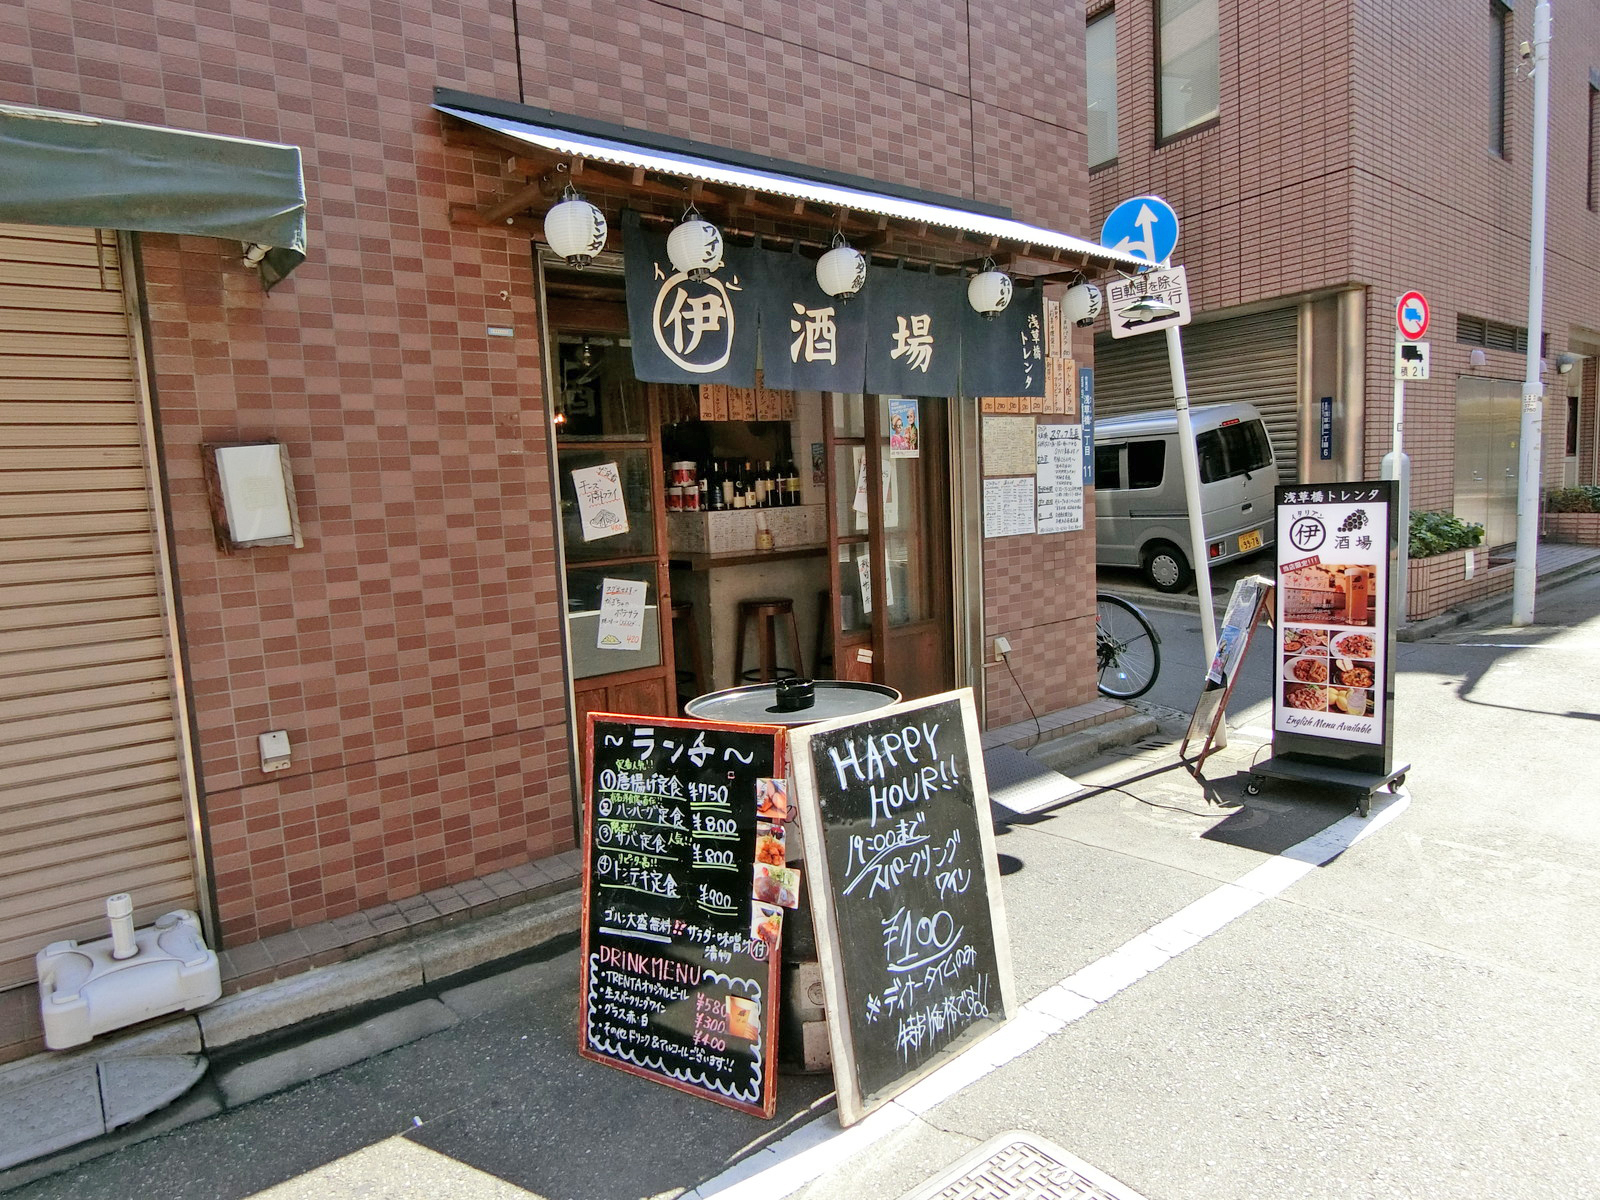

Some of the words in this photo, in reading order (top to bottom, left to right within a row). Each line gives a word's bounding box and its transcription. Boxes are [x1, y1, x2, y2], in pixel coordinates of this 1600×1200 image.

[703, 225, 720, 263] ワイン
[995, 276, 1010, 307] わいん
[1110, 274, 1181, 300] 自転車を除く
[1085, 286, 1100, 316] トレンタ
[1113, 289, 1183, 312] 一通行
[662, 287, 727, 355] 伊
[1027, 313, 1042, 361] 浅草橋
[1019, 330, 1034, 390] トレンタ
[1323, 448, 1329, 456] 6
[1083, 465, 1092, 478] 11
[579, 479, 602, 494] チーズ
[1283, 489, 1379, 504] 浅草橋トレンタ
[1295, 523, 1321, 546] 伊
[1334, 534, 1373, 551] 酒場
[1286, 715, 1314, 728] English
[1313, 718, 1337, 729] Menu
[1336, 722, 1372, 734] Available
[827, 722, 939, 790] HAPPY
[688, 781, 729, 804] ¥750
[870, 754, 959, 828] HOUR!!
[692, 812, 737, 834] ¥800
[692, 843, 734, 864] ¥800
[699, 883, 732, 908] ¥900
[935, 868, 971, 899] ワイン
[882, 906, 954, 964] ¥100
[600, 945, 650, 975] DRINK
[651, 957, 701, 986] MENU
[695, 1012, 726, 1034] ¥300
[693, 1030, 726, 1052] ¥400
